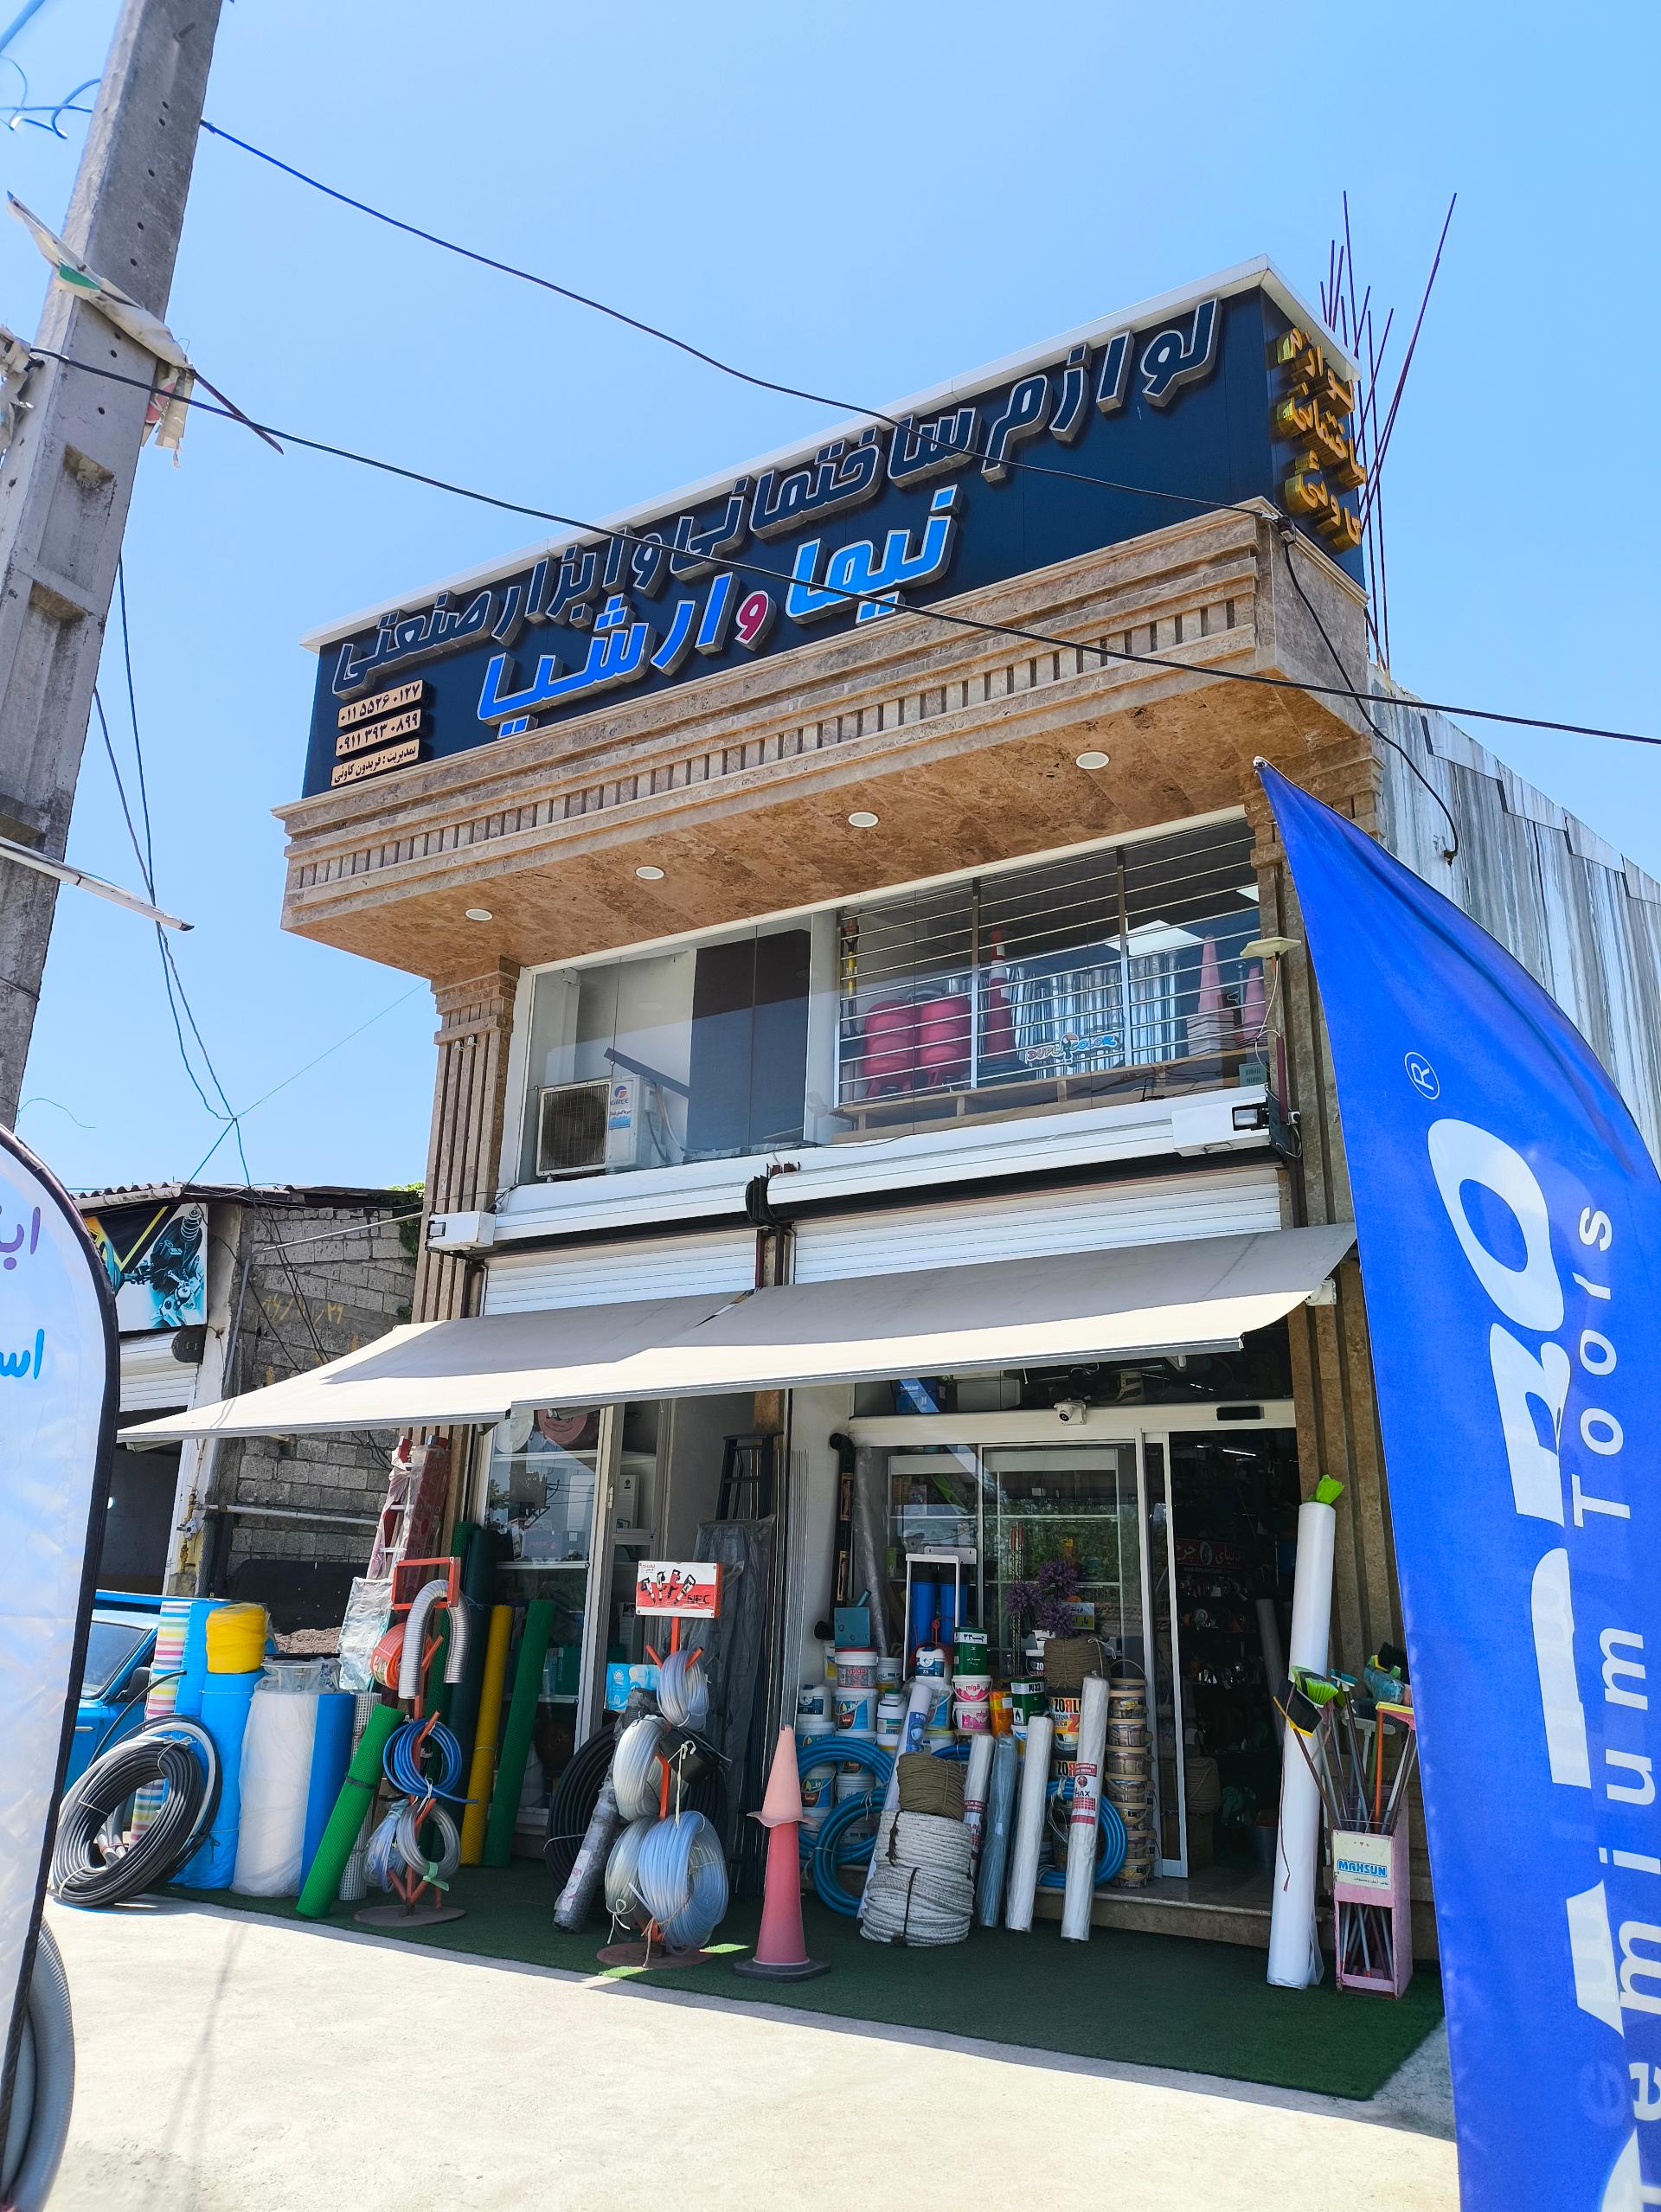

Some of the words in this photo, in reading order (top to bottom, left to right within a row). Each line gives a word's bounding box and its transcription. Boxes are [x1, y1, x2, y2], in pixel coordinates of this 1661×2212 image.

[982, 298, 1219, 478] لوازم
[670, 407, 978, 578] ساختمانی
[786, 484, 958, 625] نیما
[492, 524, 630, 640] ابزار
[632, 532, 664, 591] و
[735, 590, 770, 645] و
[332, 590, 494, 694] صنعتی
[478, 571, 734, 740] ارشیا
[1572, 1206, 1631, 1527] Tools
[1337, 1859, 1388, 1878] MAHSUN
